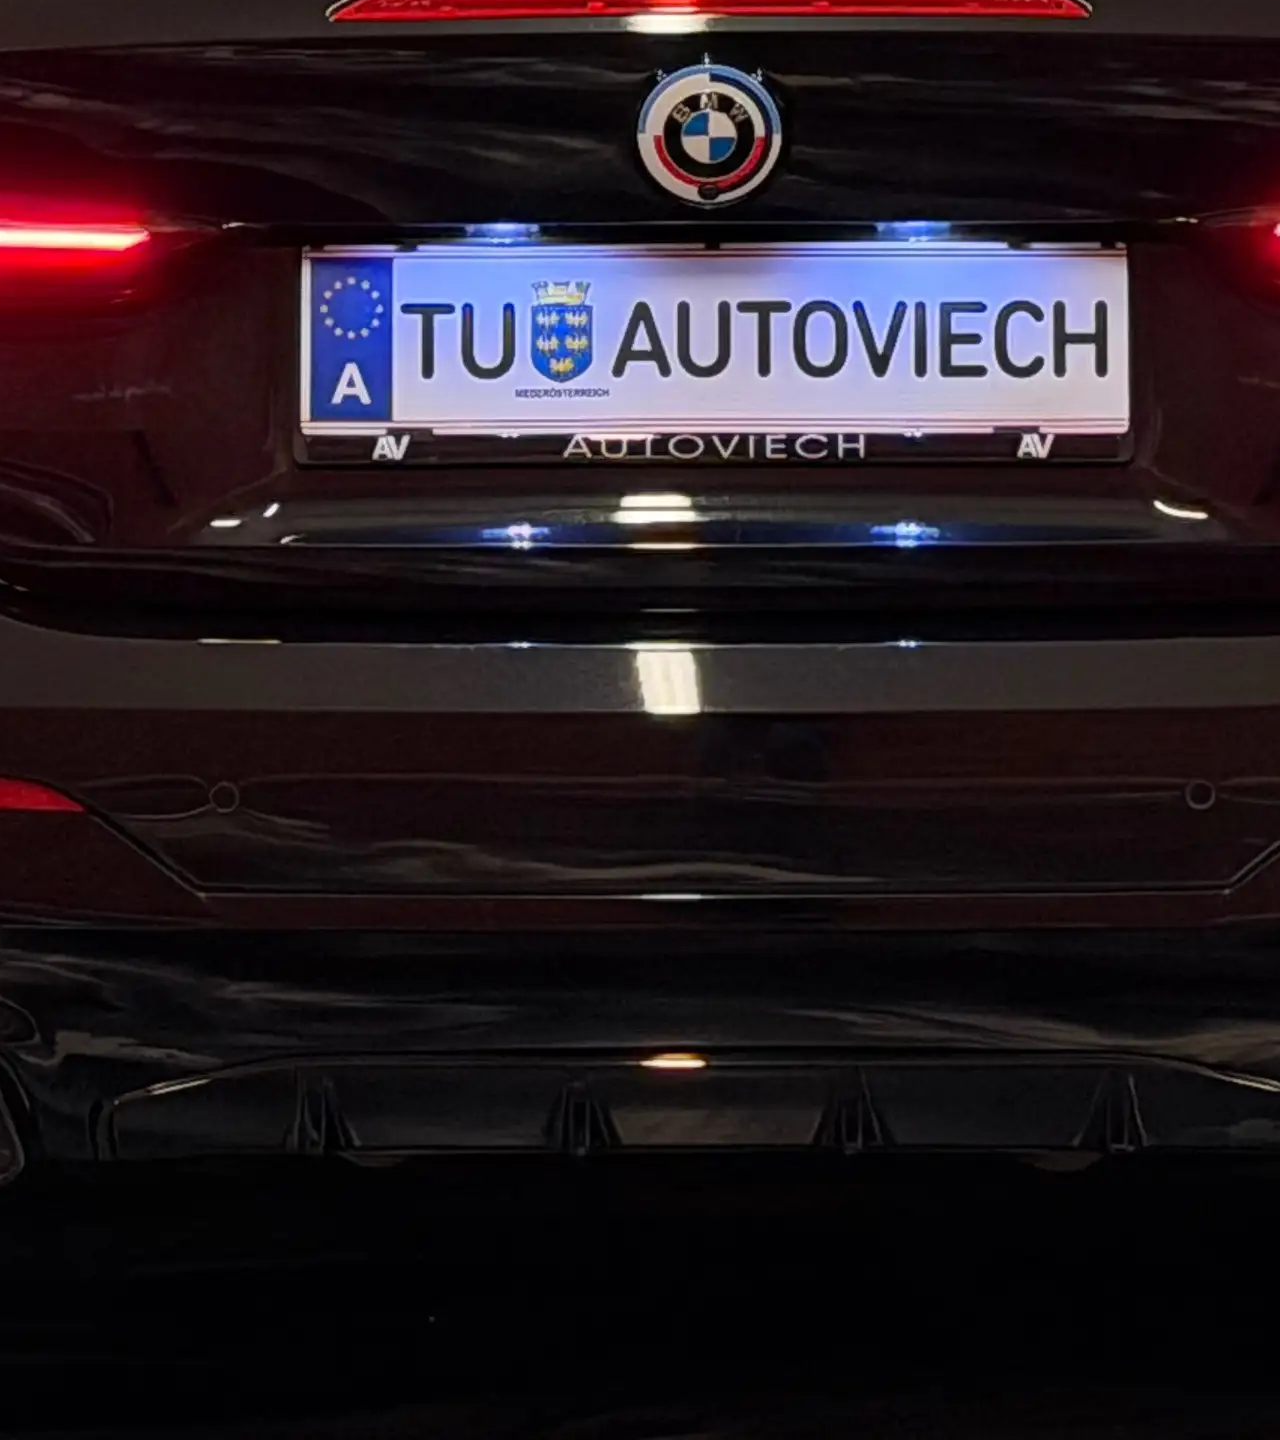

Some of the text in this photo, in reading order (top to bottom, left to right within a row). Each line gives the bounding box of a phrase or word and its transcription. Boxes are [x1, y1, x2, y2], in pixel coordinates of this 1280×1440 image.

[671, 91, 749, 123] BMW
[401, 300, 1109, 379] TU AUTOVIECH
[331, 362, 371, 405] A
[371, 433, 1055, 460] AV AUTOVIECH AV
